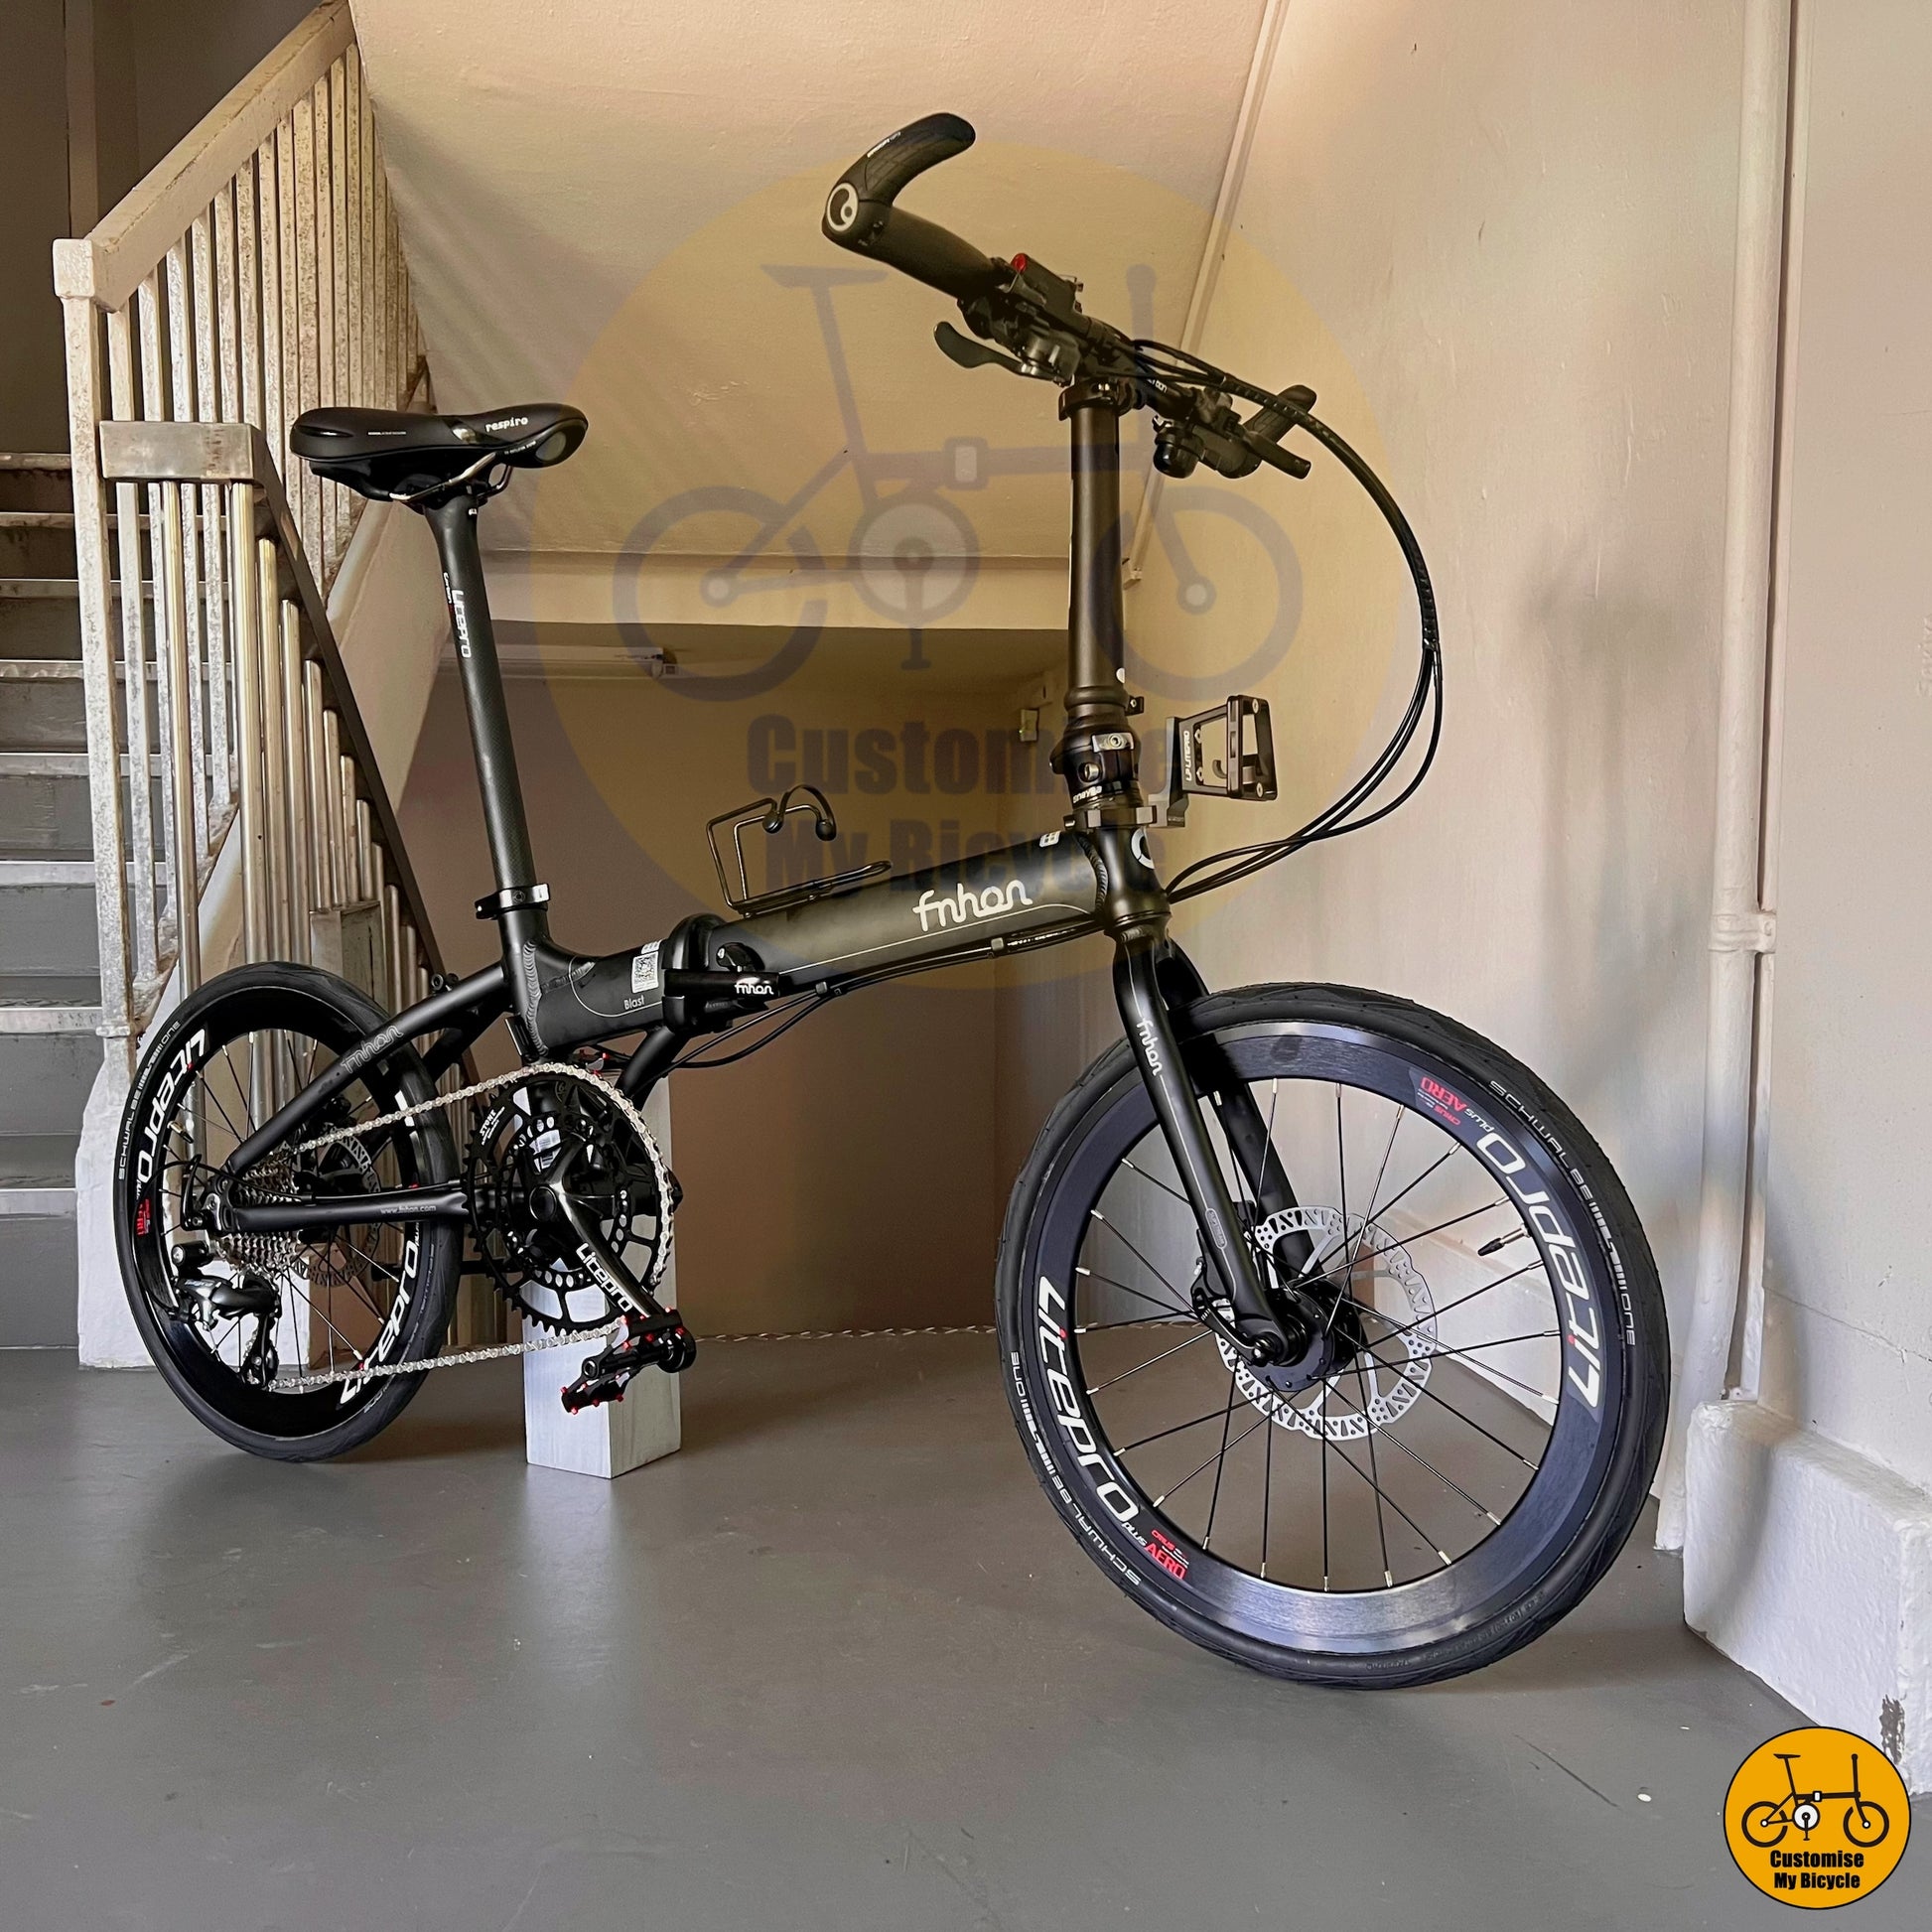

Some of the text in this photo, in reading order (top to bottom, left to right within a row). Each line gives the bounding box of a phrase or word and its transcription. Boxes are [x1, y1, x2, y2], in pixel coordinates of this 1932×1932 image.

[484, 417, 529, 433] respiro
[911, 880, 1034, 932] fnhon
[623, 995, 645, 1011] Blast
[734, 983, 774, 995] fnhon
[1136, 1018, 1163, 1076] fnhon
[118, 1021, 181, 1180] SCHWALBE ONE
[1421, 1076, 1467, 1112] AERO
[479, 1109, 497, 1136] STONE
[1463, 1108, 1495, 1133] plus
[1489, 1080, 1636, 1346] SCHWALBE ONE
[1476, 1132, 1600, 1409] Litepro
[1037, 1275, 1148, 1547] Litepro plus
[1011, 1351, 1142, 1587] SCHWALBE ONE
[1145, 1542, 1186, 1580] AERO
